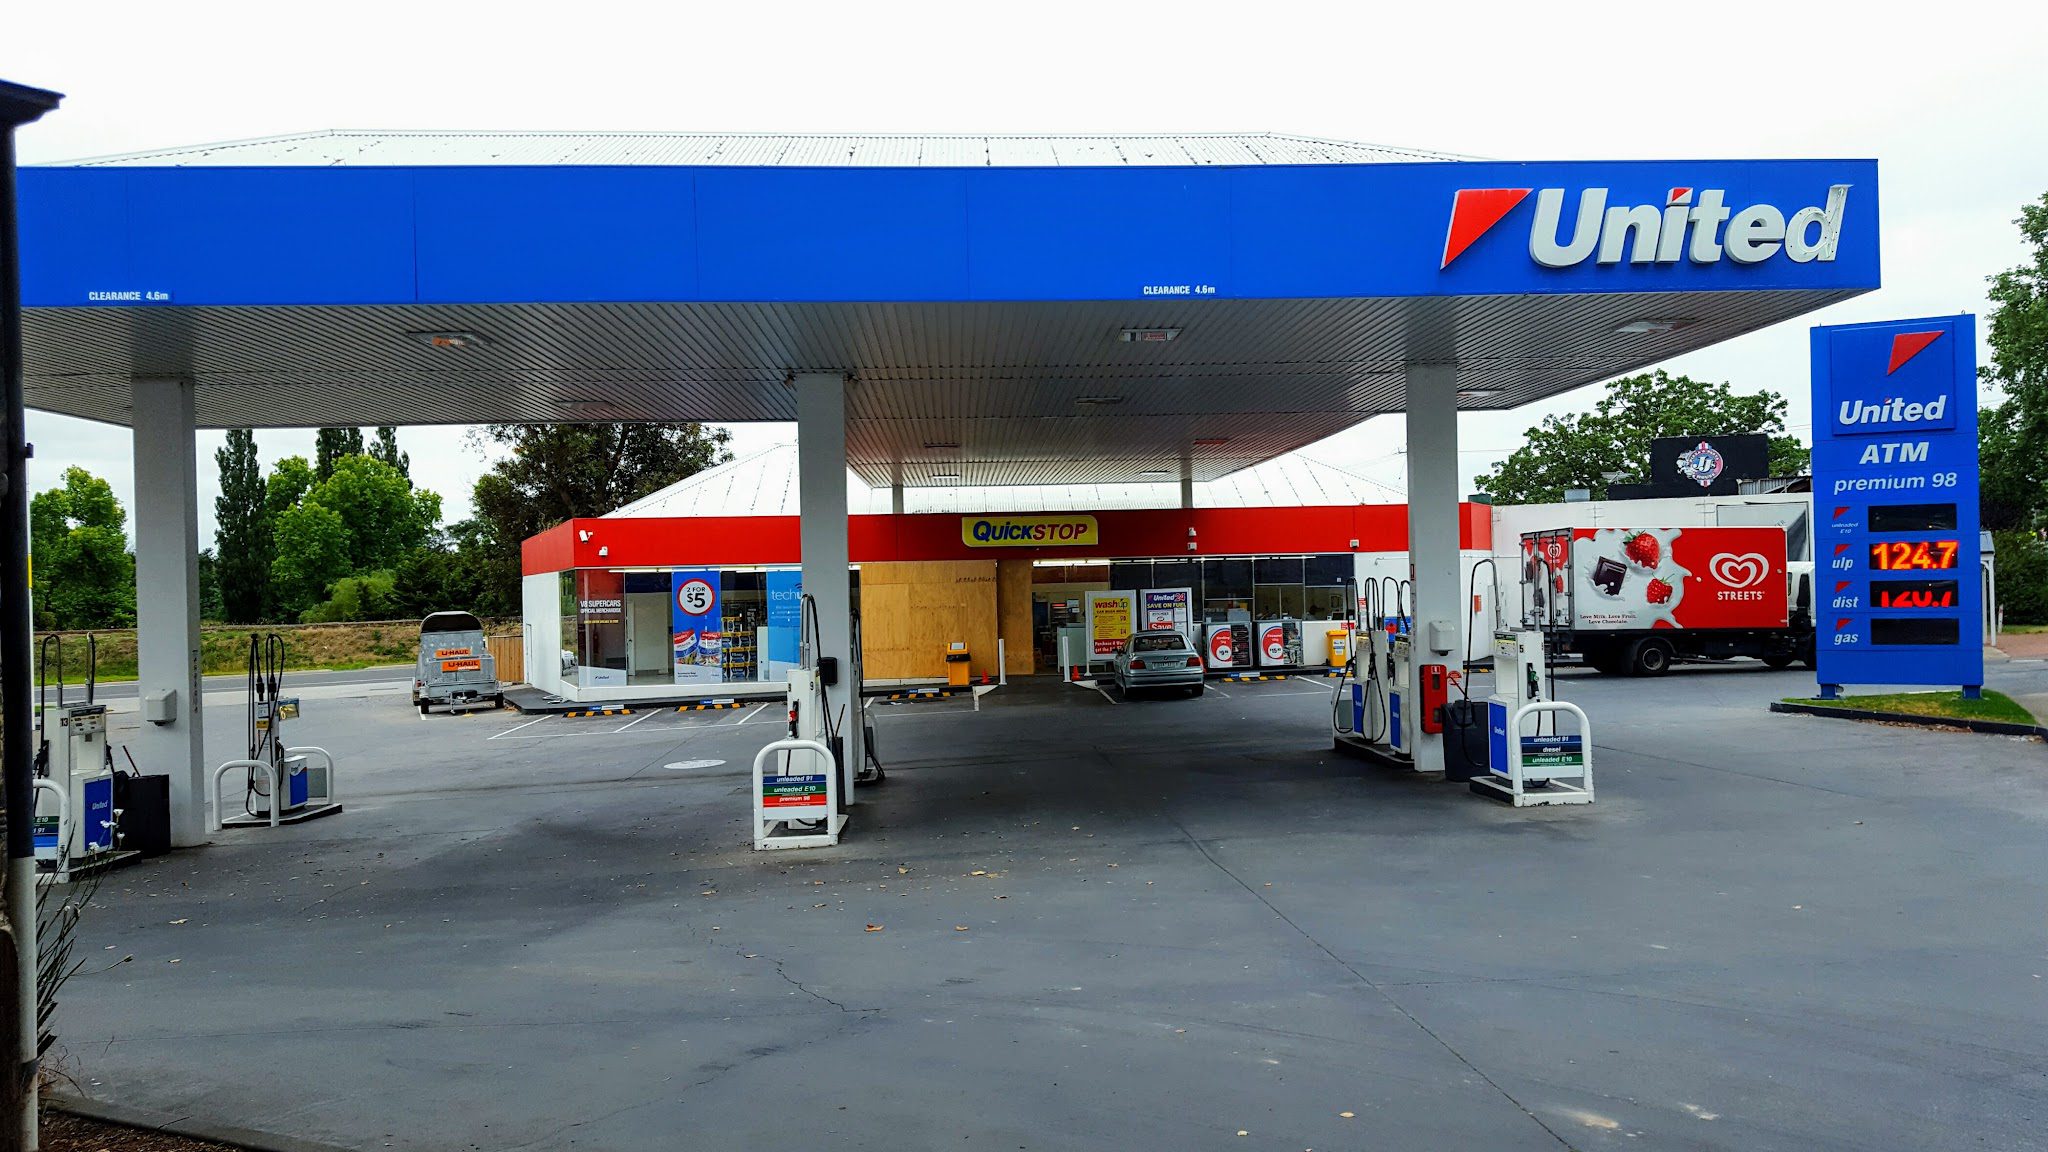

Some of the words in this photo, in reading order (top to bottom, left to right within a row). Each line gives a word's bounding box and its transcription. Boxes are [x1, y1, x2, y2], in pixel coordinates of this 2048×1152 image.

[1529, 184, 1854, 269] United
[88, 291, 141, 300] CLEARANCE
[145, 291, 169, 300] 4.6m
[1143, 286, 1190, 295] CLEARANCE
[1194, 285, 1216, 294] 4.6m
[1839, 395, 1947, 425] United
[1859, 442, 1930, 464] ATM
[1834, 475, 1925, 495] premium
[1932, 472, 1957, 488] 98
[1872, 541, 1959, 570] 124.7
[1832, 557, 1854, 571] ulp
[687, 593, 706, 608] $5
[1717, 591, 1763, 600] STREETS
[1832, 596, 1859, 608] dist
[1834, 633, 1859, 646] gas
[1519, 644, 1524, 653] 5
[60, 718, 68, 727] 13
[92, 801, 108, 810] United
